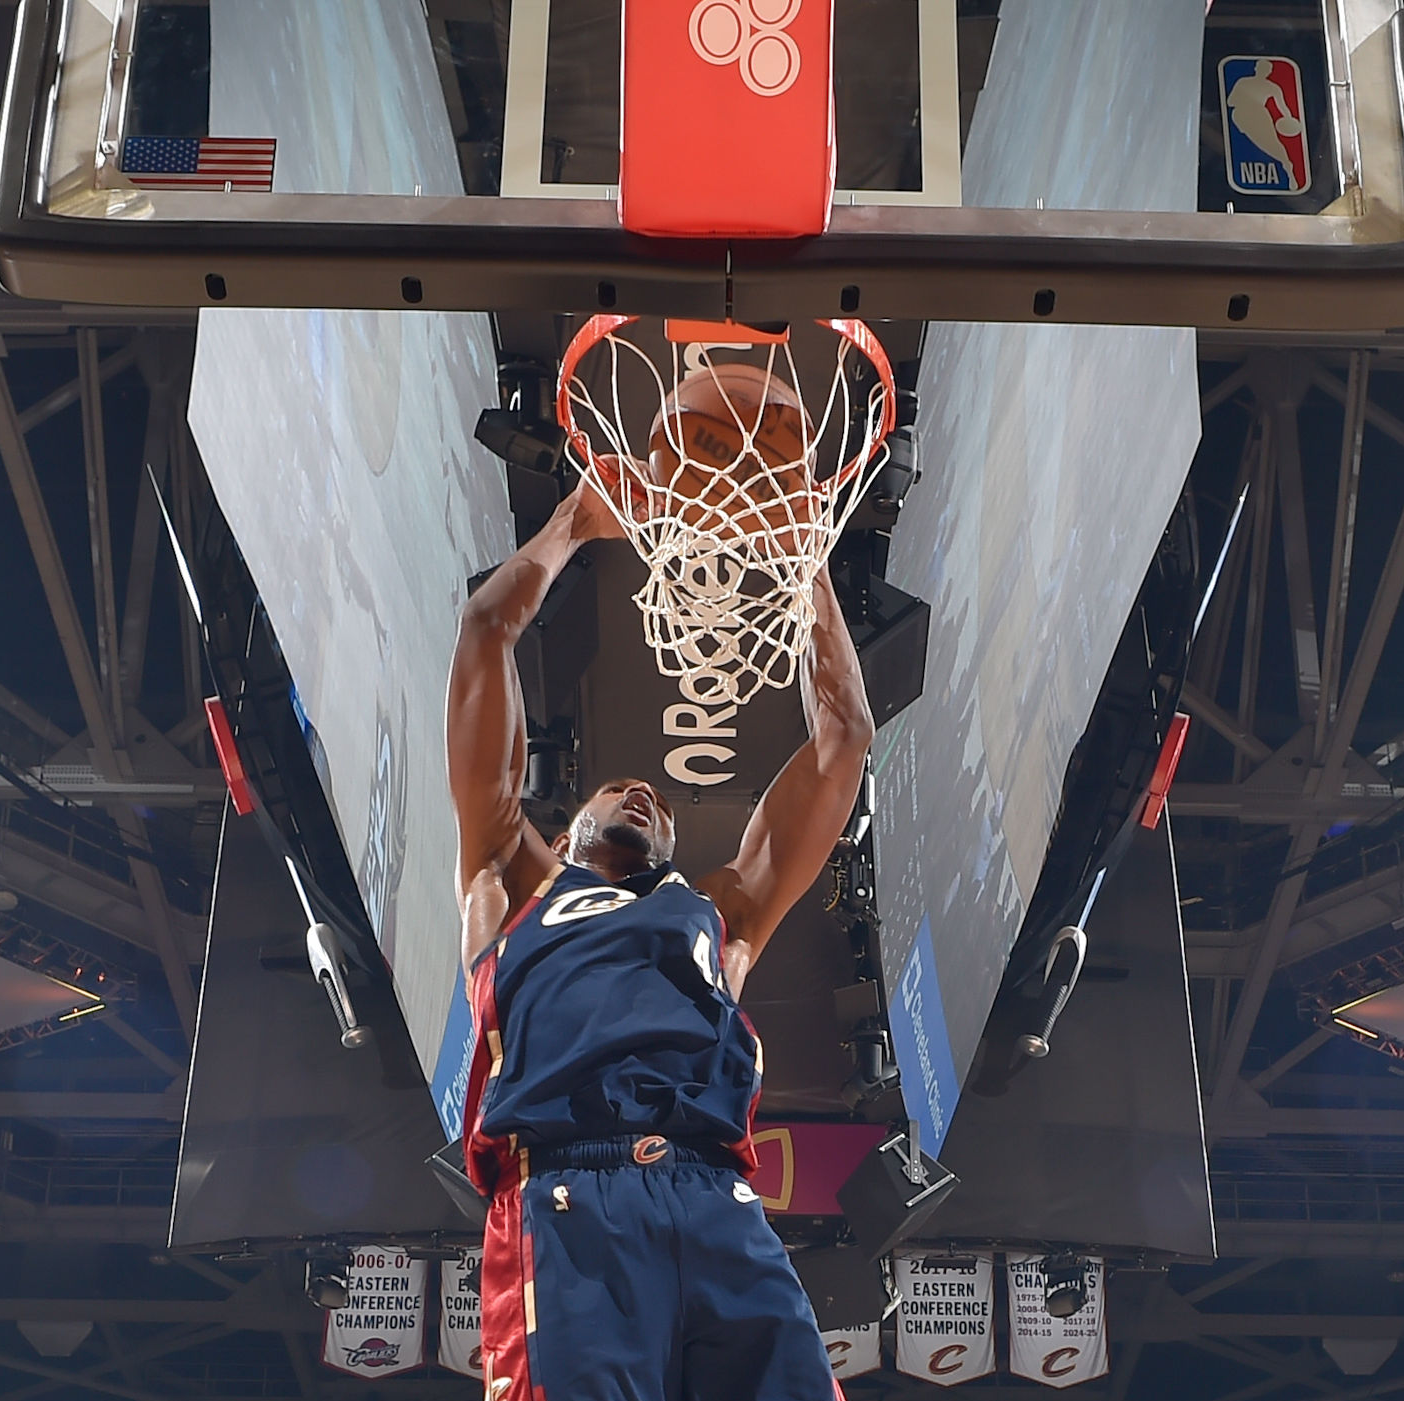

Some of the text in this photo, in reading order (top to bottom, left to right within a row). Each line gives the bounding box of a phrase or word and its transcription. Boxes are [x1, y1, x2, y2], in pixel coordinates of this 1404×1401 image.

[1240, 162, 1279, 184] NBA
[911, 992, 944, 1140] Cleveland Clinic
[349, 1277, 409, 1291] EASTERN
[913, 1283, 975, 1297] EASTERN
[901, 1301, 989, 1316] CONFERENCE
[335, 1314, 415, 1328] CHAMPIONS
[905, 1320, 986, 1336] CHAMPIONS
[1017, 1329, 1098, 1337] 2014-15 2024-25
